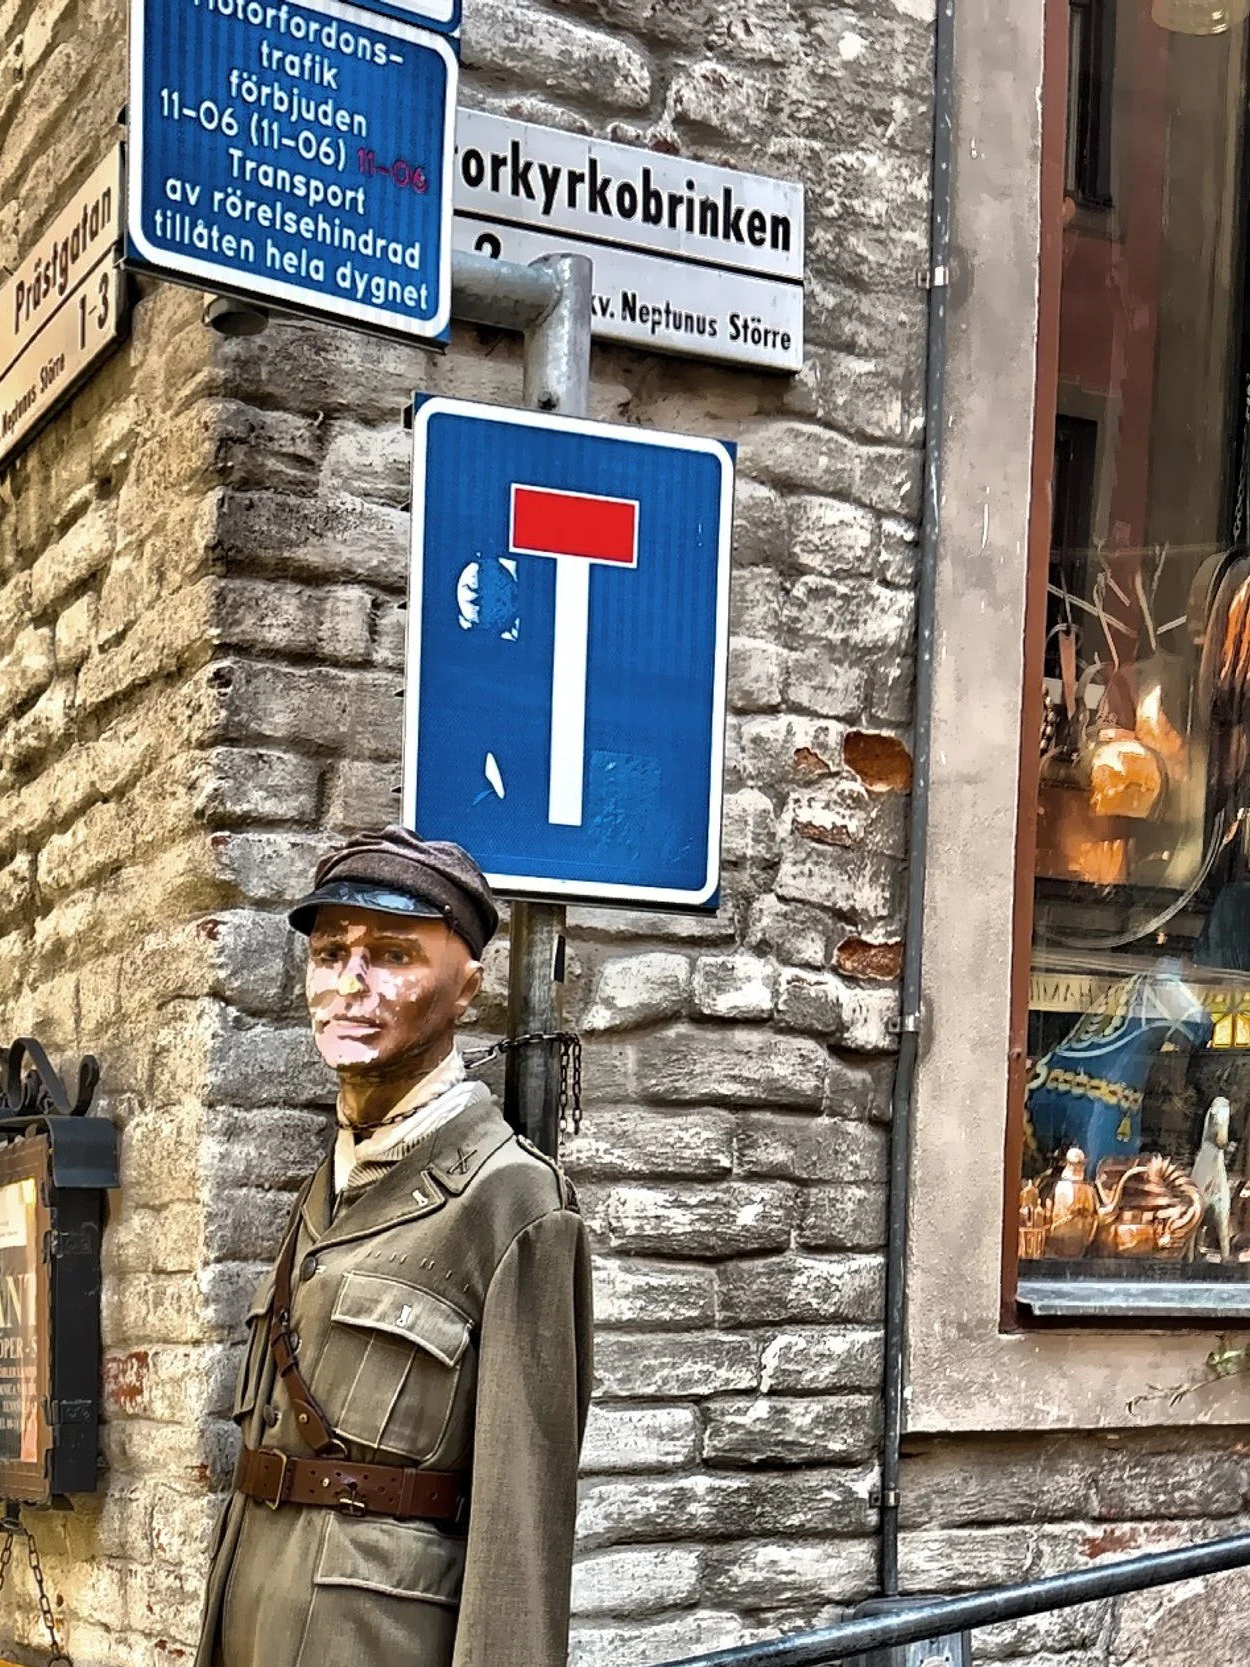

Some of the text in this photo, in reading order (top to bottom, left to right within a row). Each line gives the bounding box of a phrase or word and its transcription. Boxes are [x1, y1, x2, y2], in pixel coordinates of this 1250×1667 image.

[193, 0, 403, 65] otorfordons-
[261, 40, 339, 90] trafik
[161, 88, 239, 137] 11-06
[250, 112, 347, 172] (11-06)
[229, 69, 367, 137] förbjuden
[228, 148, 366, 215] Transport
[454, 141, 791, 252] orkyrkobrinken
[14, 186, 112, 335] Prästgatan
[154, 209, 428, 310] tillåten hela dygnet
[165, 177, 200, 207] av
[213, 187, 421, 270] rörelsehindrad
[78, 272, 110, 350] 1-3
[621, 290, 718, 337] Neptunus
[729, 313, 792, 351] Större
